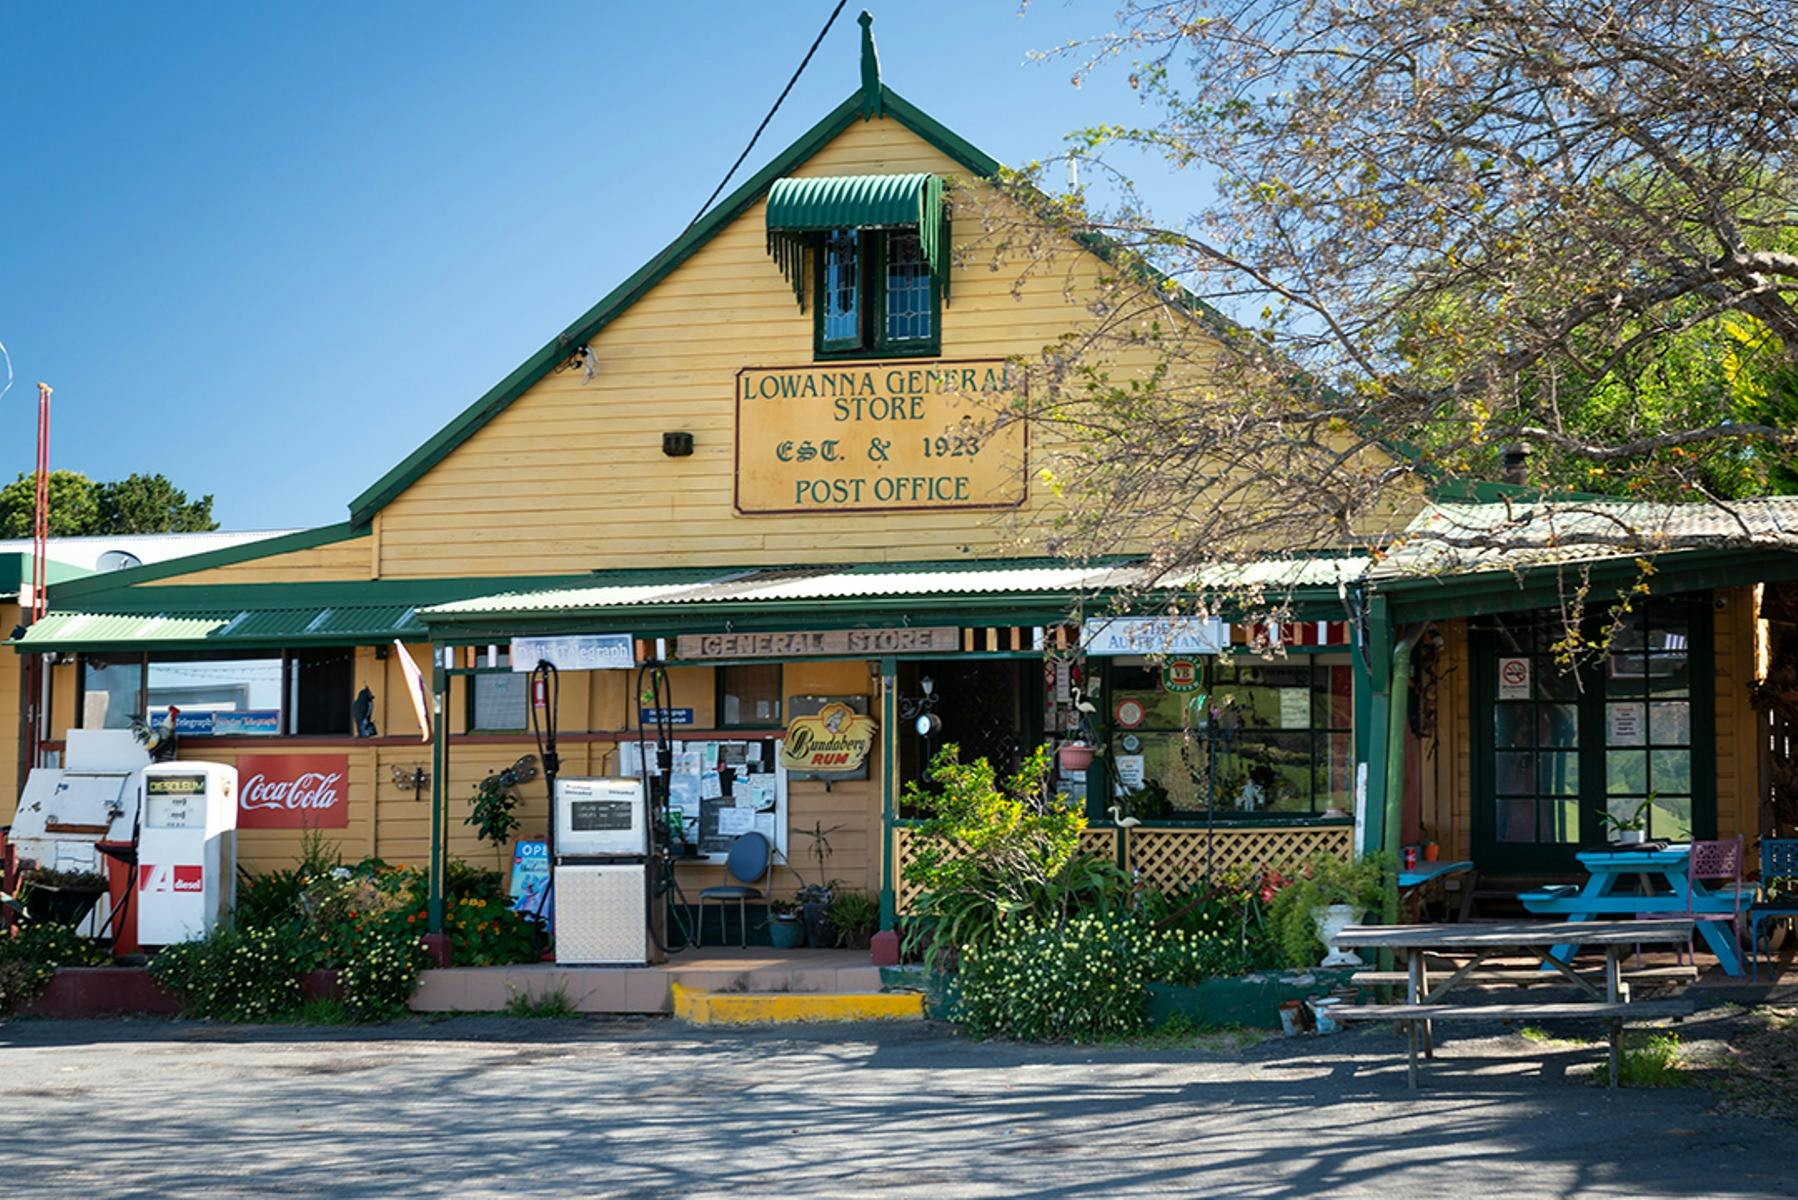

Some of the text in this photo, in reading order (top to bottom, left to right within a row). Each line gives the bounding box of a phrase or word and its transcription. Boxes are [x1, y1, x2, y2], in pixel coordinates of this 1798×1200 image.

[744, 368, 1013, 400] LOWANNA GENERAL
[833, 396, 926, 422] STORE
[776, 440, 845, 462] EST.
[867, 437, 891, 461] &
[795, 476, 970, 504] POST OFFICE
[557, 642, 628, 663] Telegraph
[701, 629, 933, 656] GENERAL STORE
[1108, 635, 1201, 650] AUTRAIAN
[786, 725, 866, 760] Bundaberg
[811, 753, 849, 765] RUM
[240, 772, 342, 810] Coca-Cola
[521, 844, 548, 856] OPE
[175, 879, 201, 890] diesel
